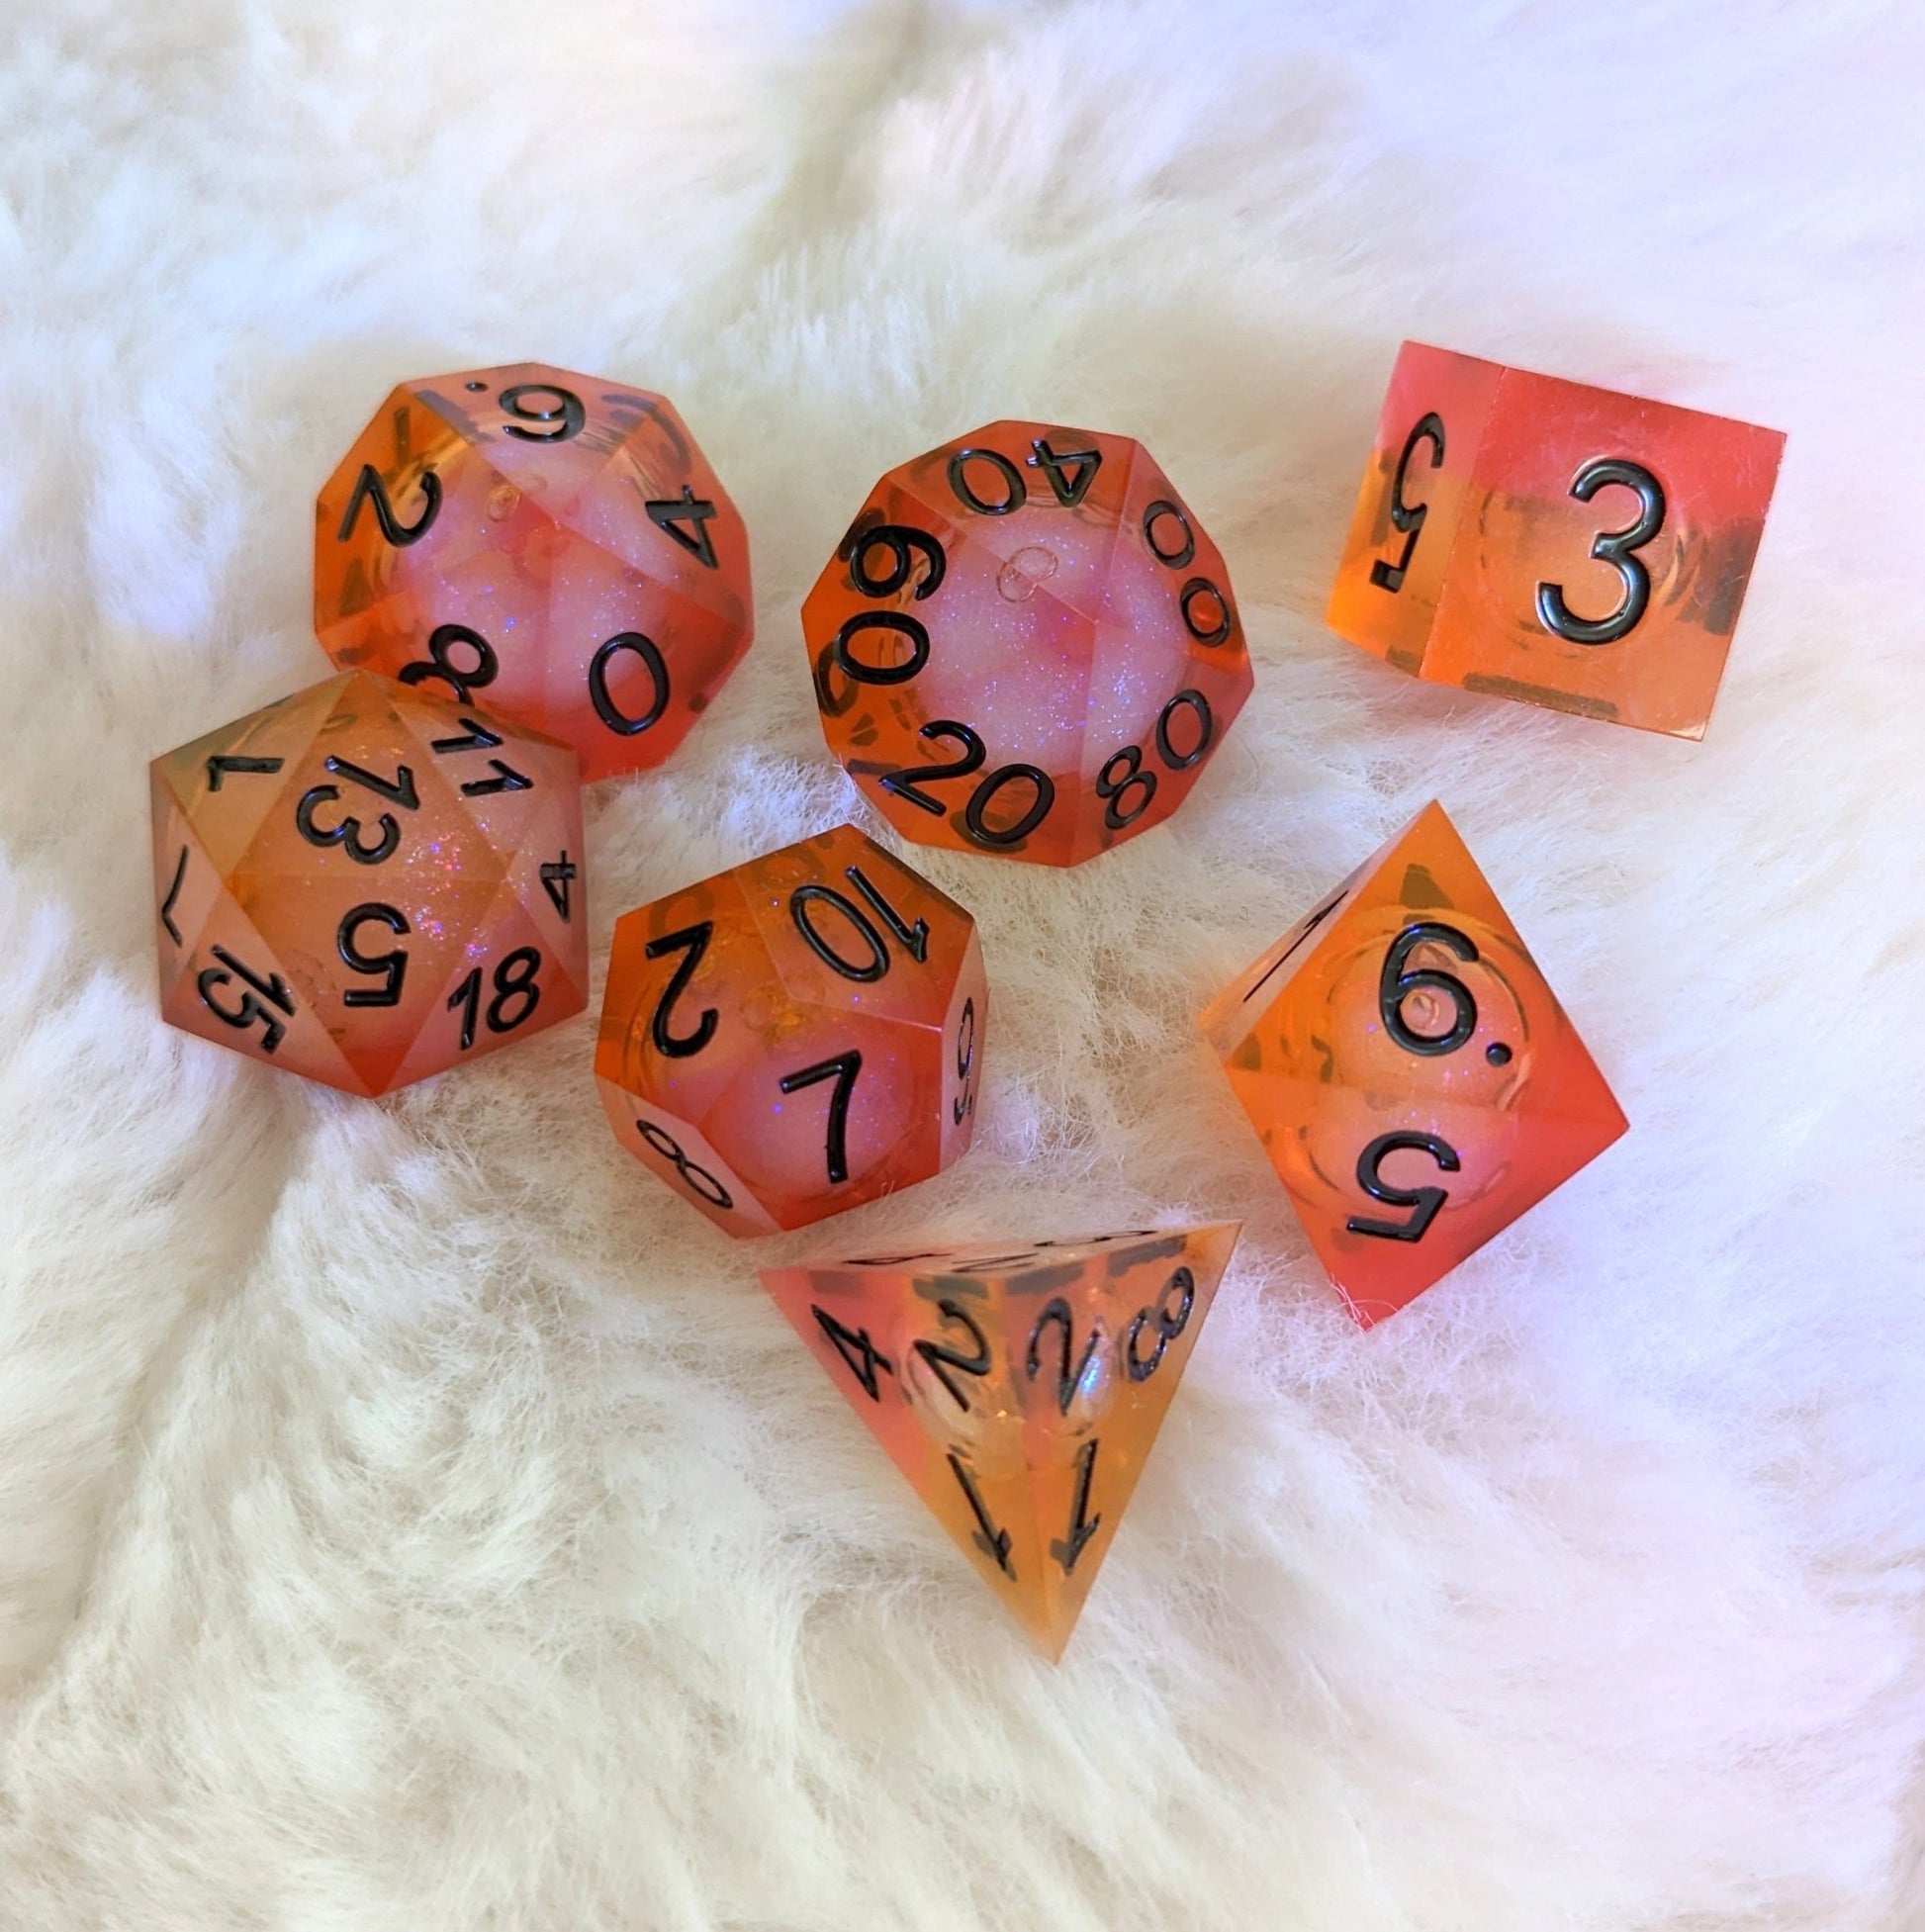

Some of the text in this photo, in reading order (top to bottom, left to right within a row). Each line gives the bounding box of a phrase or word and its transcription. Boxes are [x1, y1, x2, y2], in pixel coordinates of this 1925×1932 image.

[337, 463, 443, 548] 2
[644, 484, 720, 571] 4
[947, 438, 1103, 516] 40
[1368, 411, 1446, 595] 5
[834, 524, 947, 686] 60
[1143, 499, 1232, 648] 00
[1534, 456, 1667, 646] 3
[588, 631, 671, 737] 0
[296, 754, 419, 866] 13
[430, 717, 535, 798] 11
[877, 719, 1055, 846] 20
[1096, 689, 1213, 831] 80
[538, 850, 578, 924] 4
[790, 865, 931, 983] 10
[198, 944, 296, 1055] 15
[336, 901, 412, 1009] 5
[446, 946, 542, 1053] 18
[644, 920, 719, 1059] 2
[635, 1118, 734, 1210] 8
[778, 1049, 864, 1185] 7
[1345, 1130, 1462, 1244] 5
[811, 1302, 894, 1402] 4
[913, 1298, 991, 1413] 2
[1026, 1297, 1100, 1417] 2
